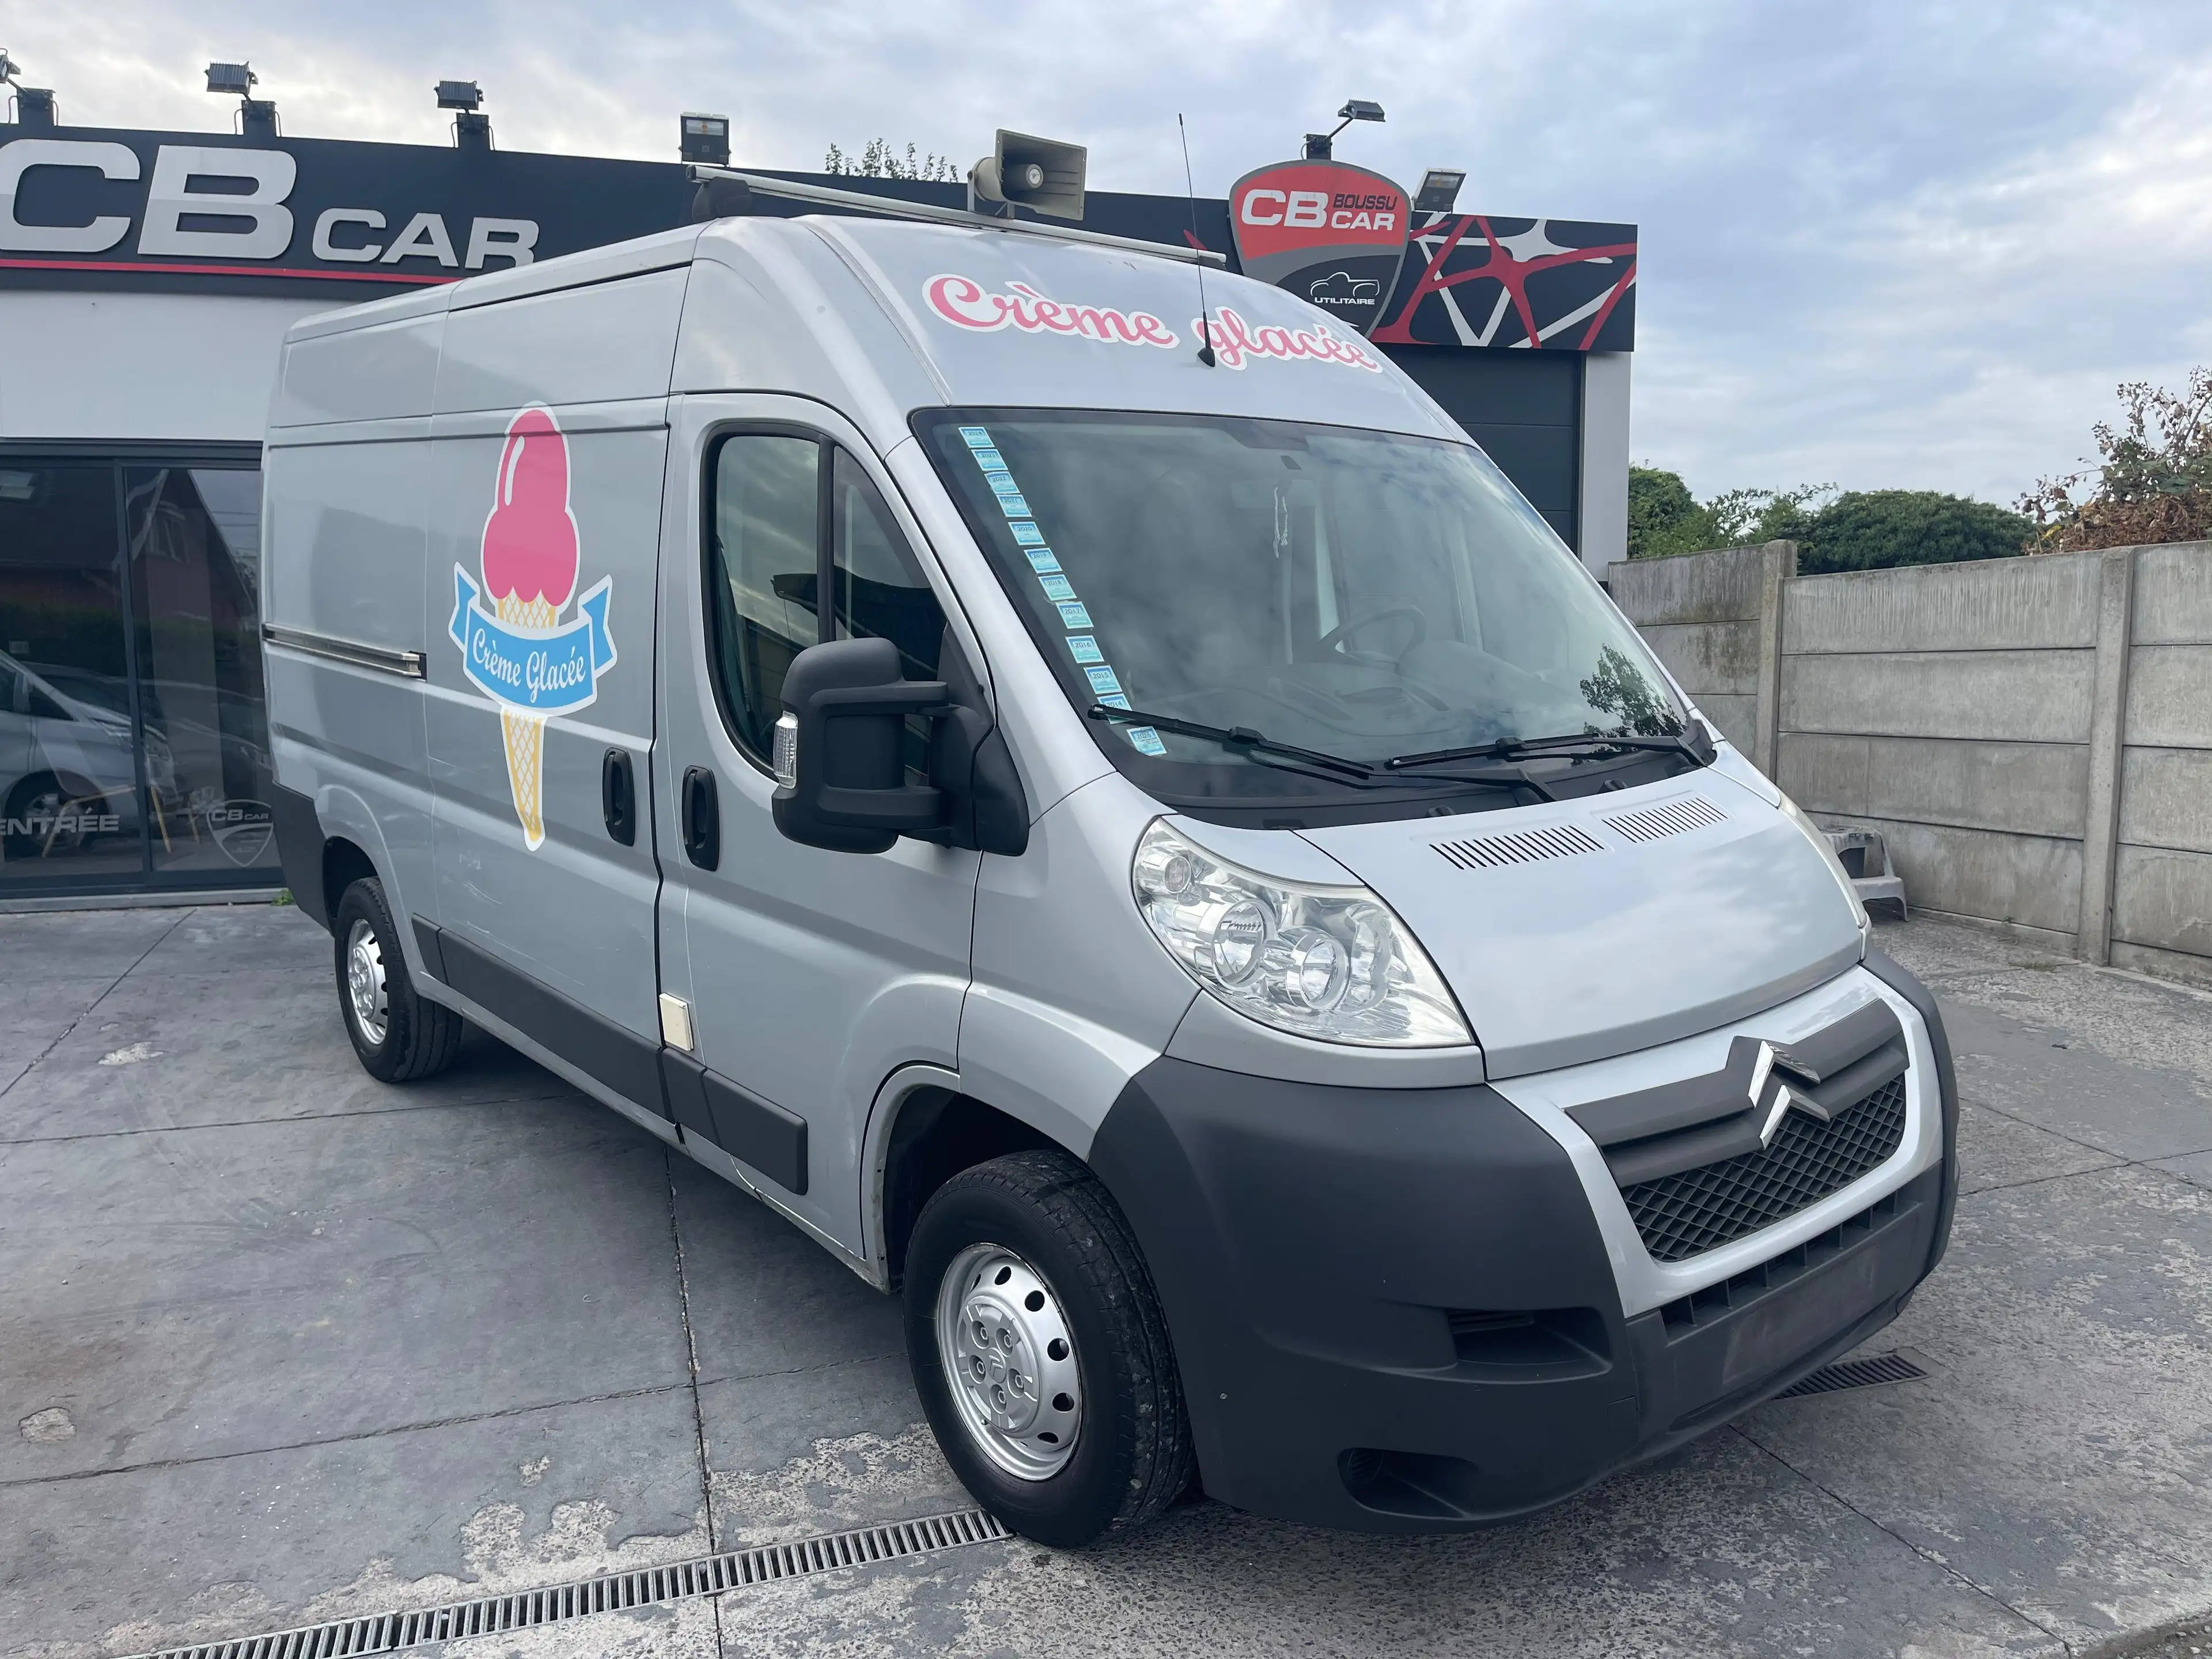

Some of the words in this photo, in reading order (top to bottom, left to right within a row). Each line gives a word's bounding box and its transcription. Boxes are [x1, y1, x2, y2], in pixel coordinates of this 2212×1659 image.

[0, 139, 297, 259] CB
[312, 207, 539, 269] CAR
[1241, 189, 1328, 229] CB
[1333, 194, 1397, 210] BOUSSU
[1331, 211, 1396, 232] CAR
[1314, 297, 1376, 305] UTILITAIRE
[928, 276, 1173, 345] Crème
[1195, 308, 1378, 367] glacée
[472, 628, 521, 687] Crème
[525, 646, 586, 703] Glacée
[211, 809, 243, 821] CB
